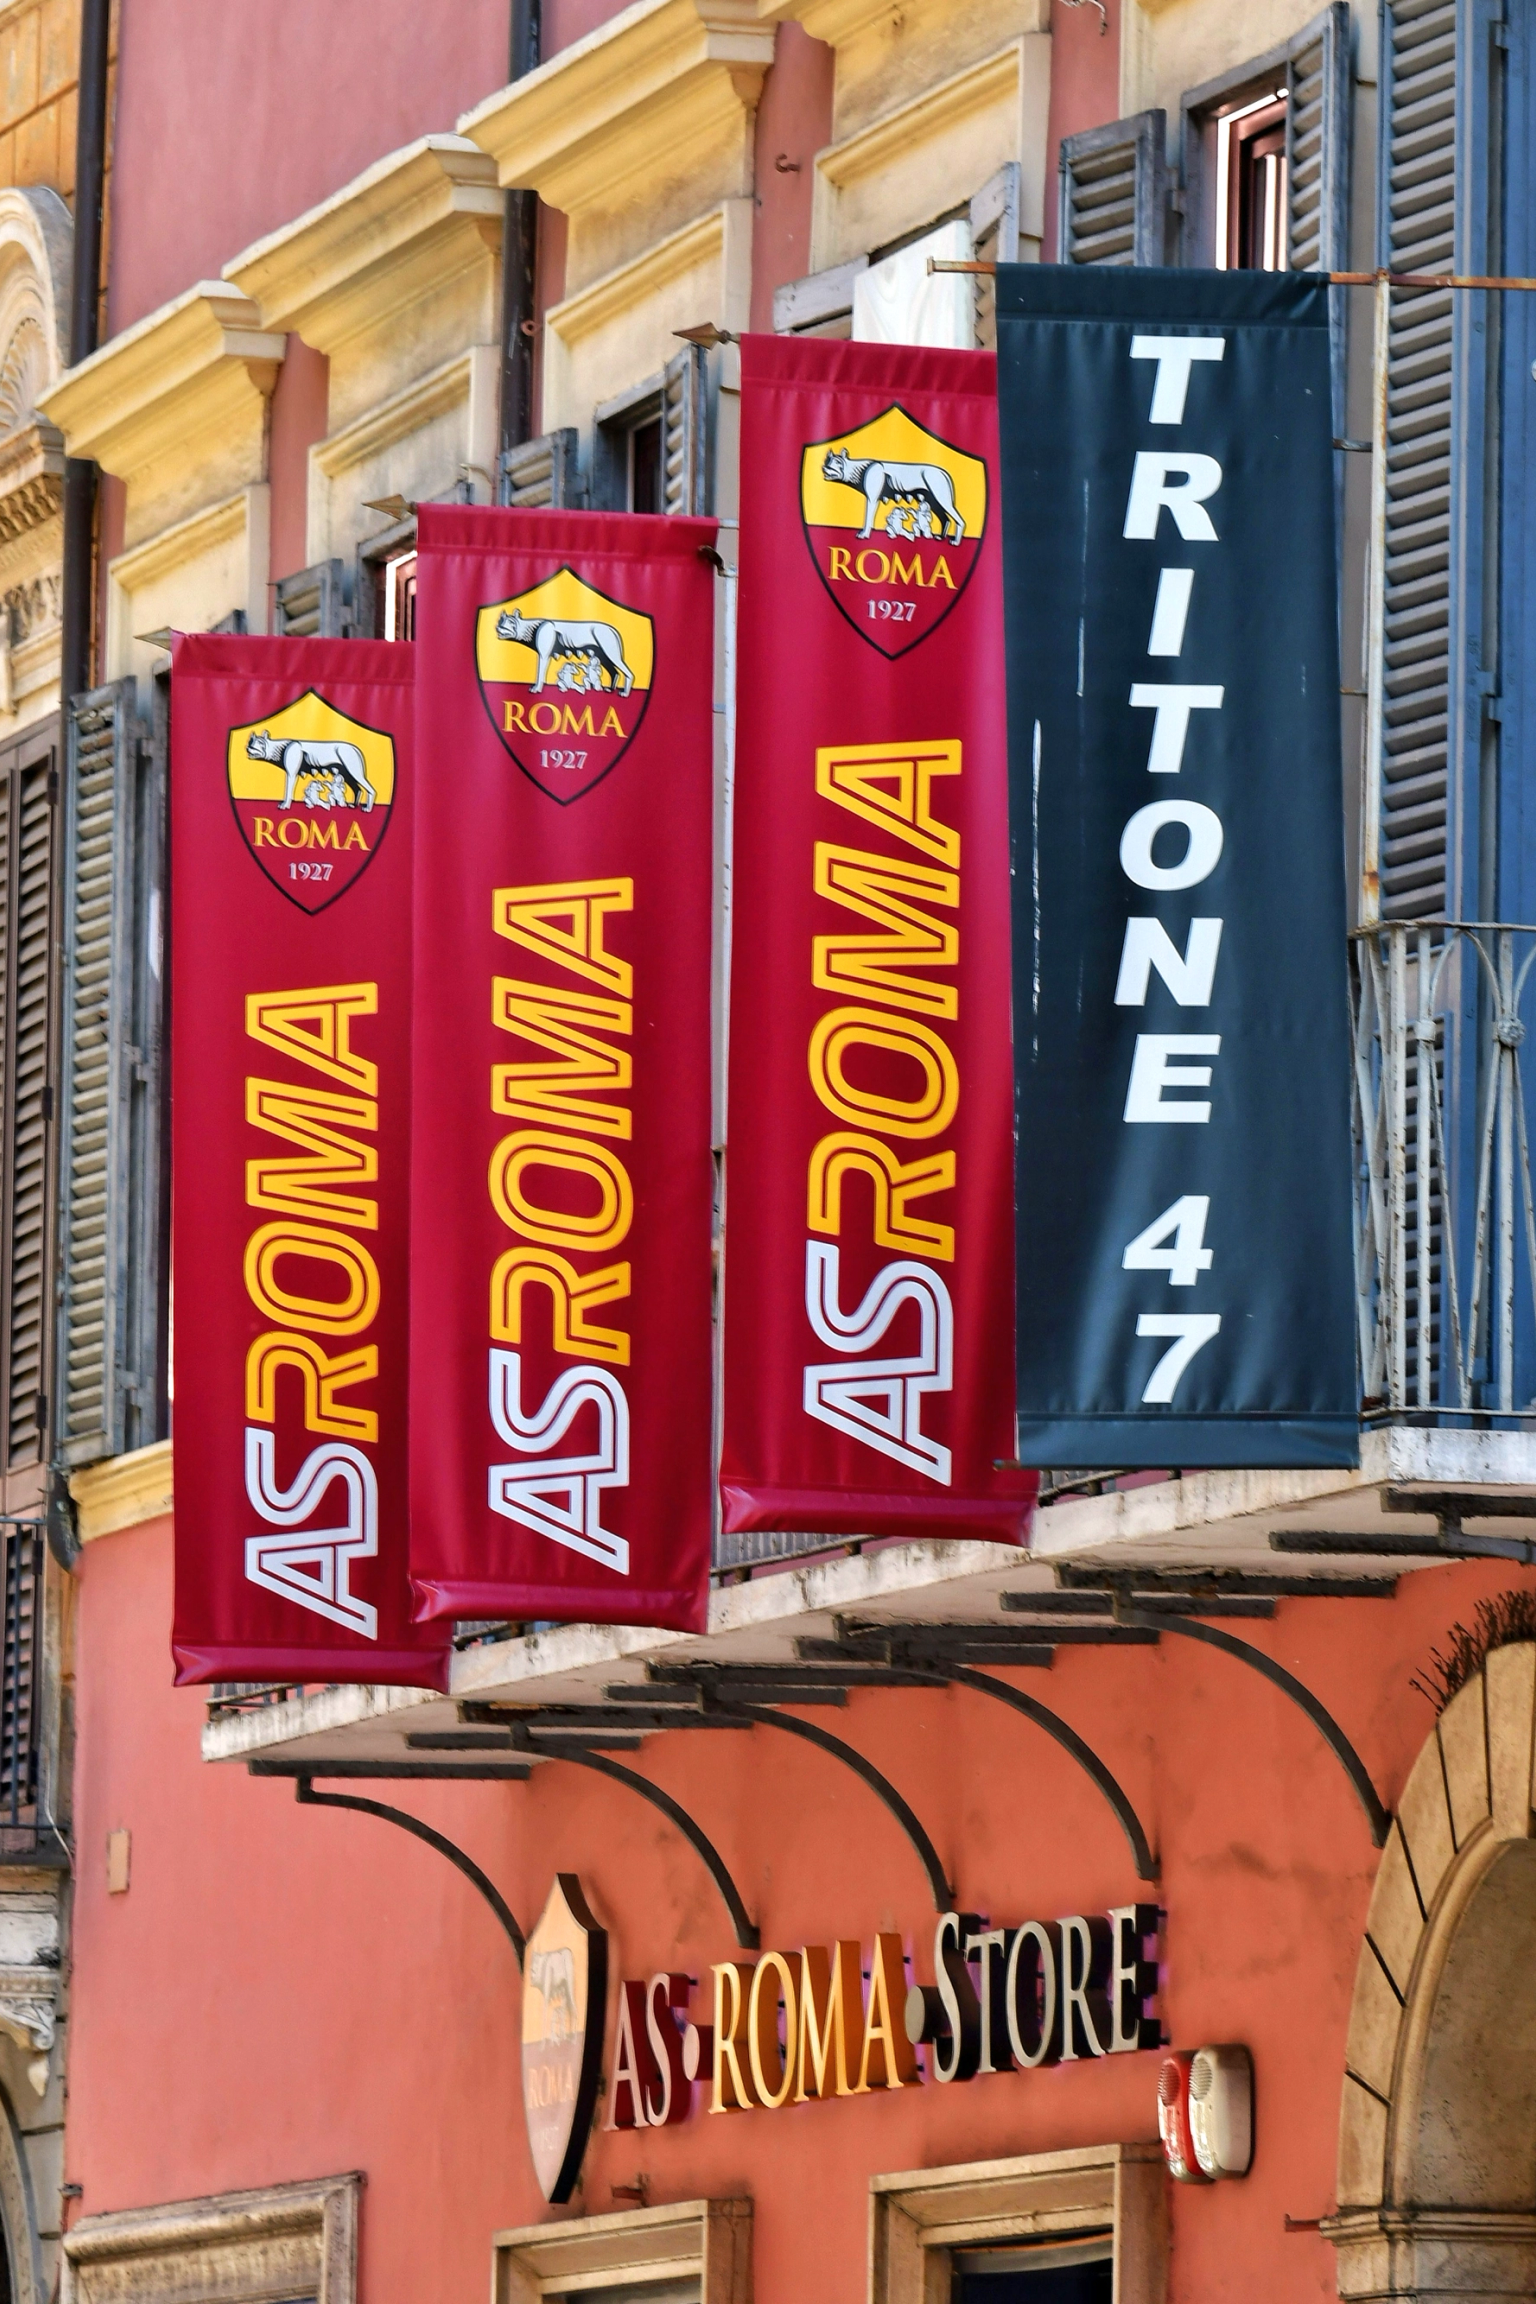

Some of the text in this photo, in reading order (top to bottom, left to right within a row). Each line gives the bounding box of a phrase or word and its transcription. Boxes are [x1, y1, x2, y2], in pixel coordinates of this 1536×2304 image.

[828, 545, 958, 590] ROMA
[866, 599, 917, 622] 1927
[502, 699, 628, 738] ROMA
[1113, 334, 1227, 1125] TRITONE
[539, 748, 588, 769] 1927
[252, 816, 371, 851] ROMA
[288, 861, 334, 881] 1927
[1121, 1194, 1222, 1404] 47
[932, 1903, 1141, 2084] STORE
